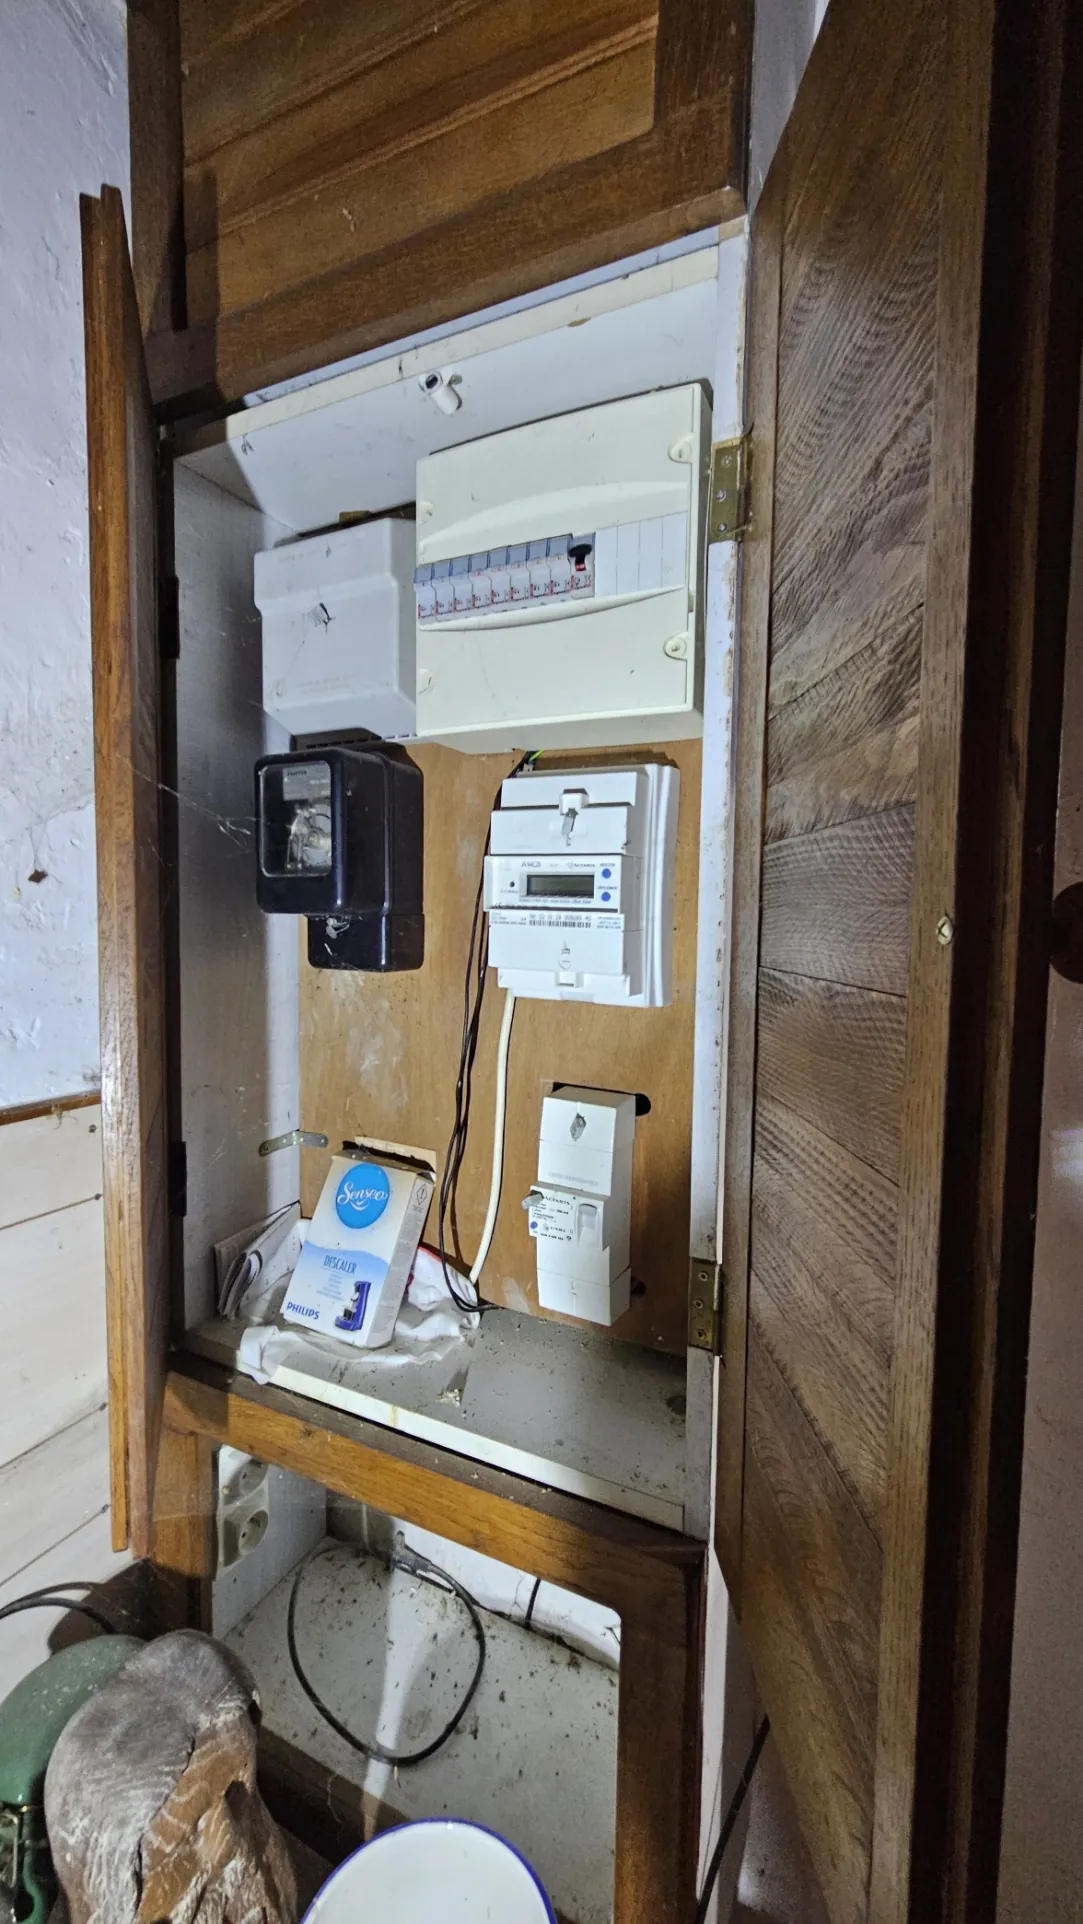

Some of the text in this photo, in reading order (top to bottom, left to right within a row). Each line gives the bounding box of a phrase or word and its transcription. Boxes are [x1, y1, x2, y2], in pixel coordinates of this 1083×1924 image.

[337, 1181, 388, 1206] Senseo
[323, 1255, 357, 1274] DESCALER
[286, 1302, 321, 1320] PHILIPS
